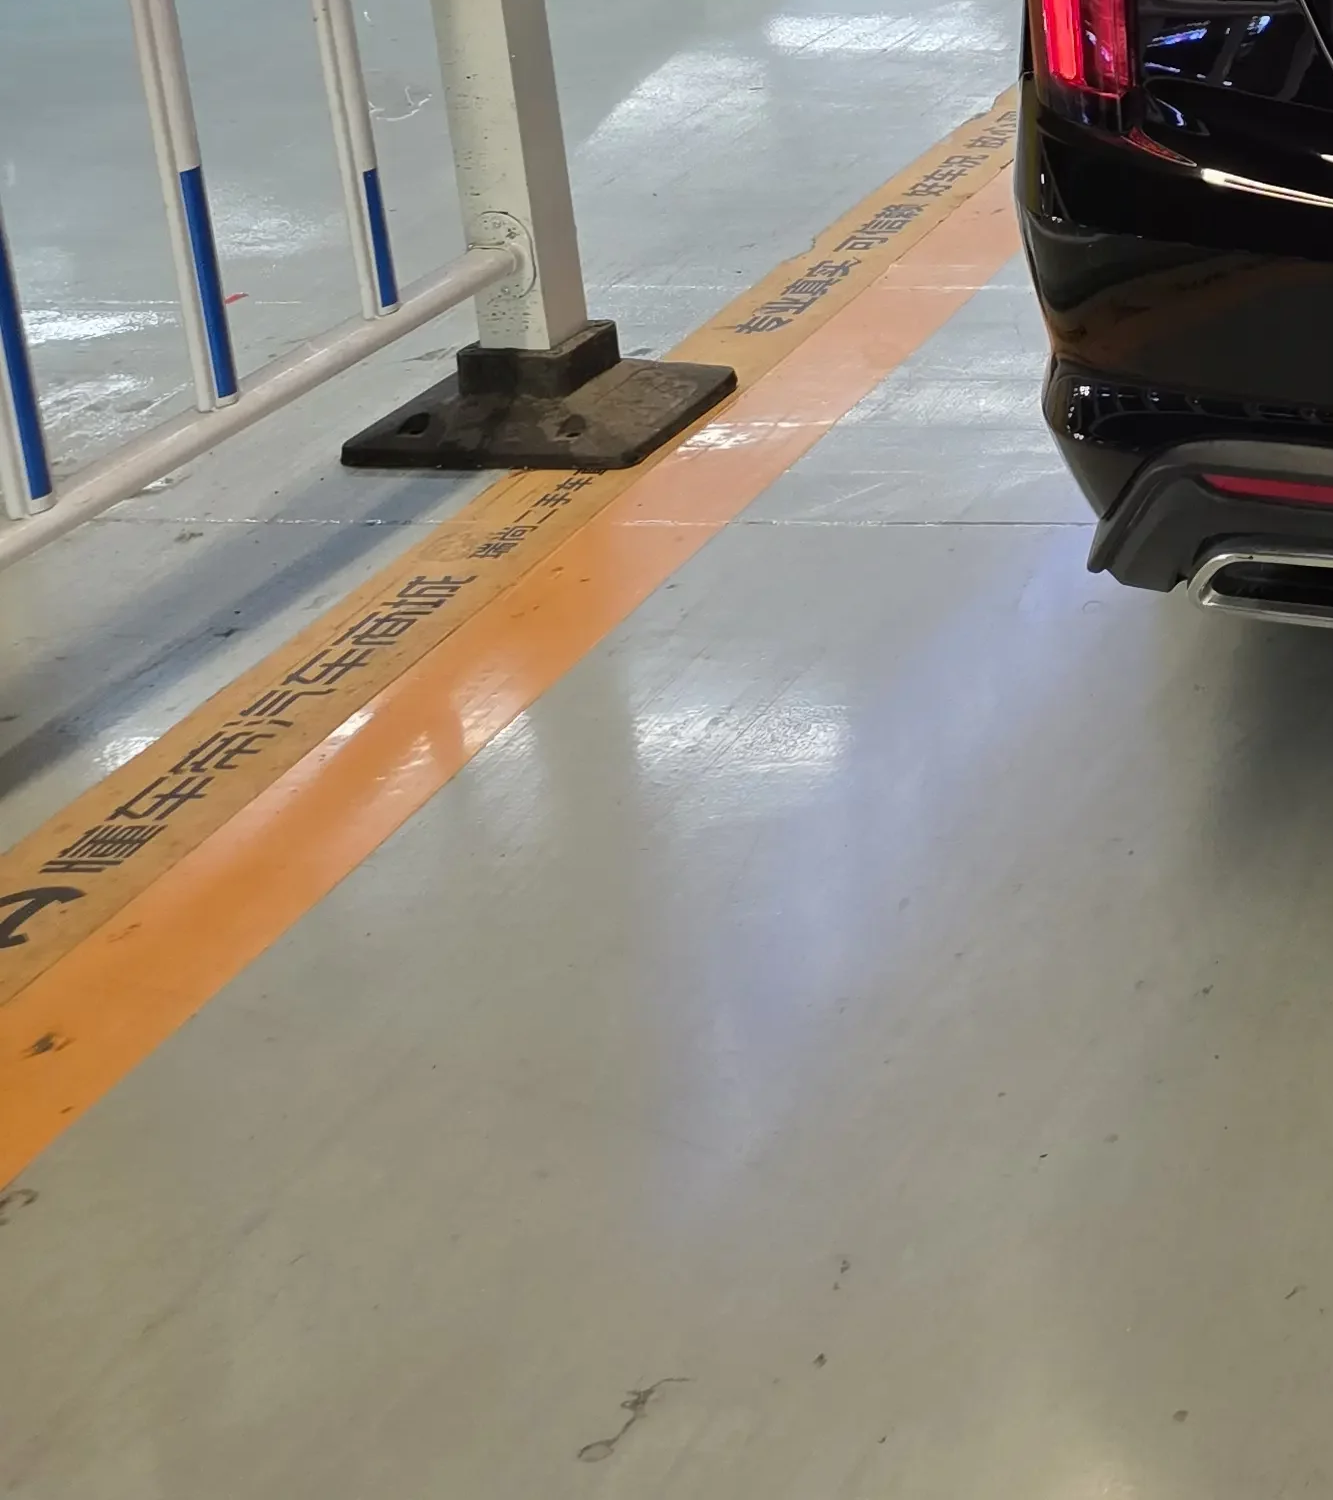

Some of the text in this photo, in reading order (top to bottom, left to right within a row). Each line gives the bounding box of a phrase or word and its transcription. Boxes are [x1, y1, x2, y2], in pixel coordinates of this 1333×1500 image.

[735, 256, 862, 334] 专业真实
[902, 154, 989, 198] 好车况
[39, 575, 477, 874] 懂车帝汽车商城
